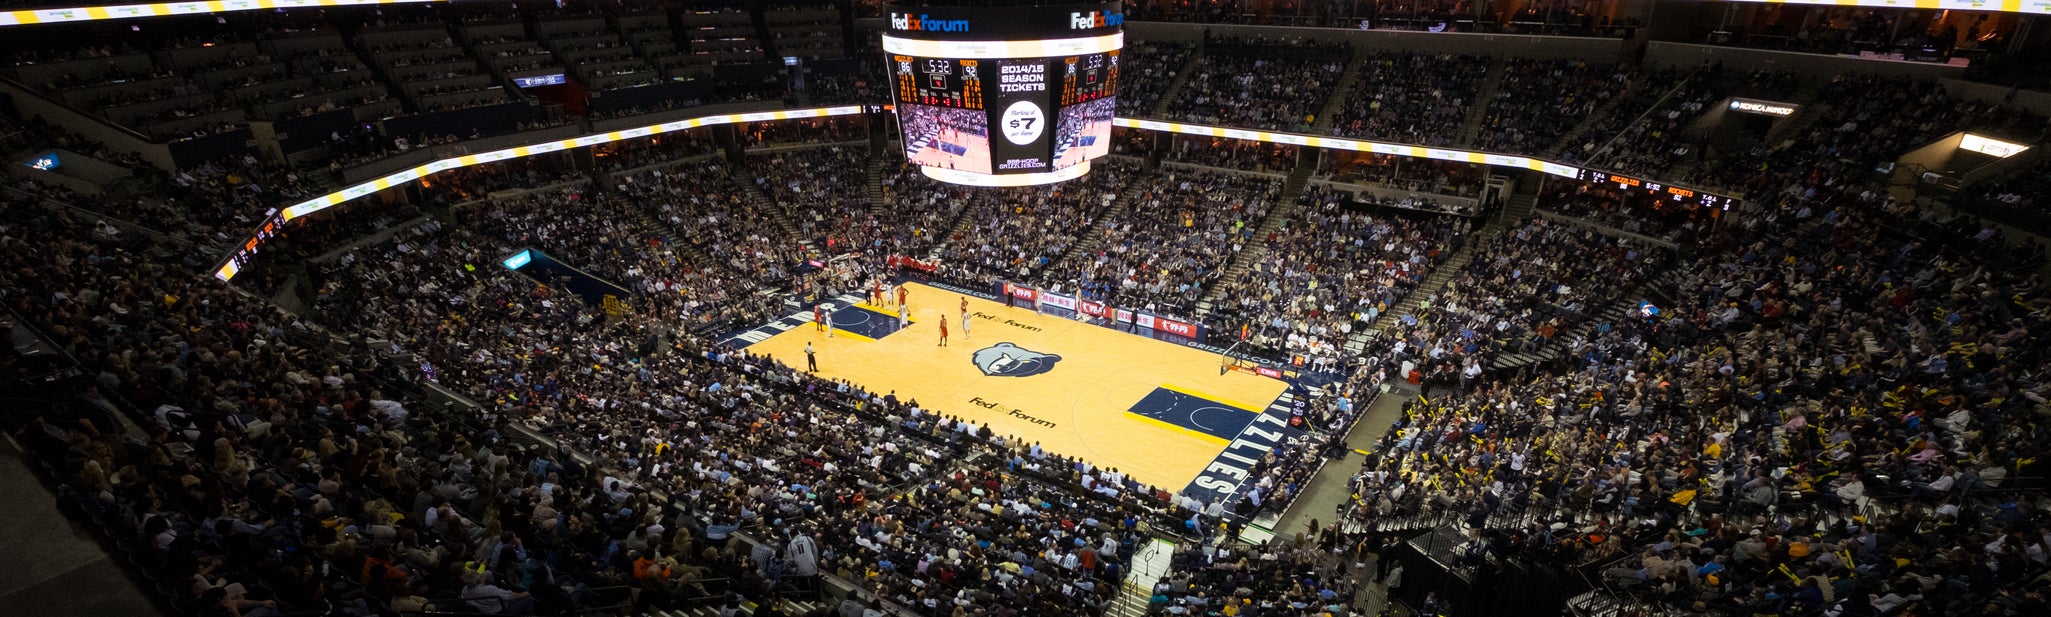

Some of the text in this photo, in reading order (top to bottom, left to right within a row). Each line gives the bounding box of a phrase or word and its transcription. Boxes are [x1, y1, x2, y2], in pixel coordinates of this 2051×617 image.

[891, 12, 969, 32] FedExForum
[900, 62, 911, 72] 86
[965, 66, 976, 76] 92
[1001, 64, 1045, 74] 2014/15
[1001, 74, 1044, 83] SEASON
[999, 82, 1046, 92] TICKETS
[1739, 102, 1765, 112] KONICA
[1010, 117, 1037, 130] $7
[999, 162, 1046, 170] GRIZZLIES.COM
[1610, 175, 1640, 187] GRIZZLIES
[1667, 186, 1694, 198] ROCKETS
[928, 281, 998, 300] GRIZZLIES.COM
[973, 311, 1042, 333] FedExForum
[1187, 341, 1284, 369] GRIZZIS.COM
[968, 396, 1057, 430] FedExForum
[796, 543, 805, 554] 11
